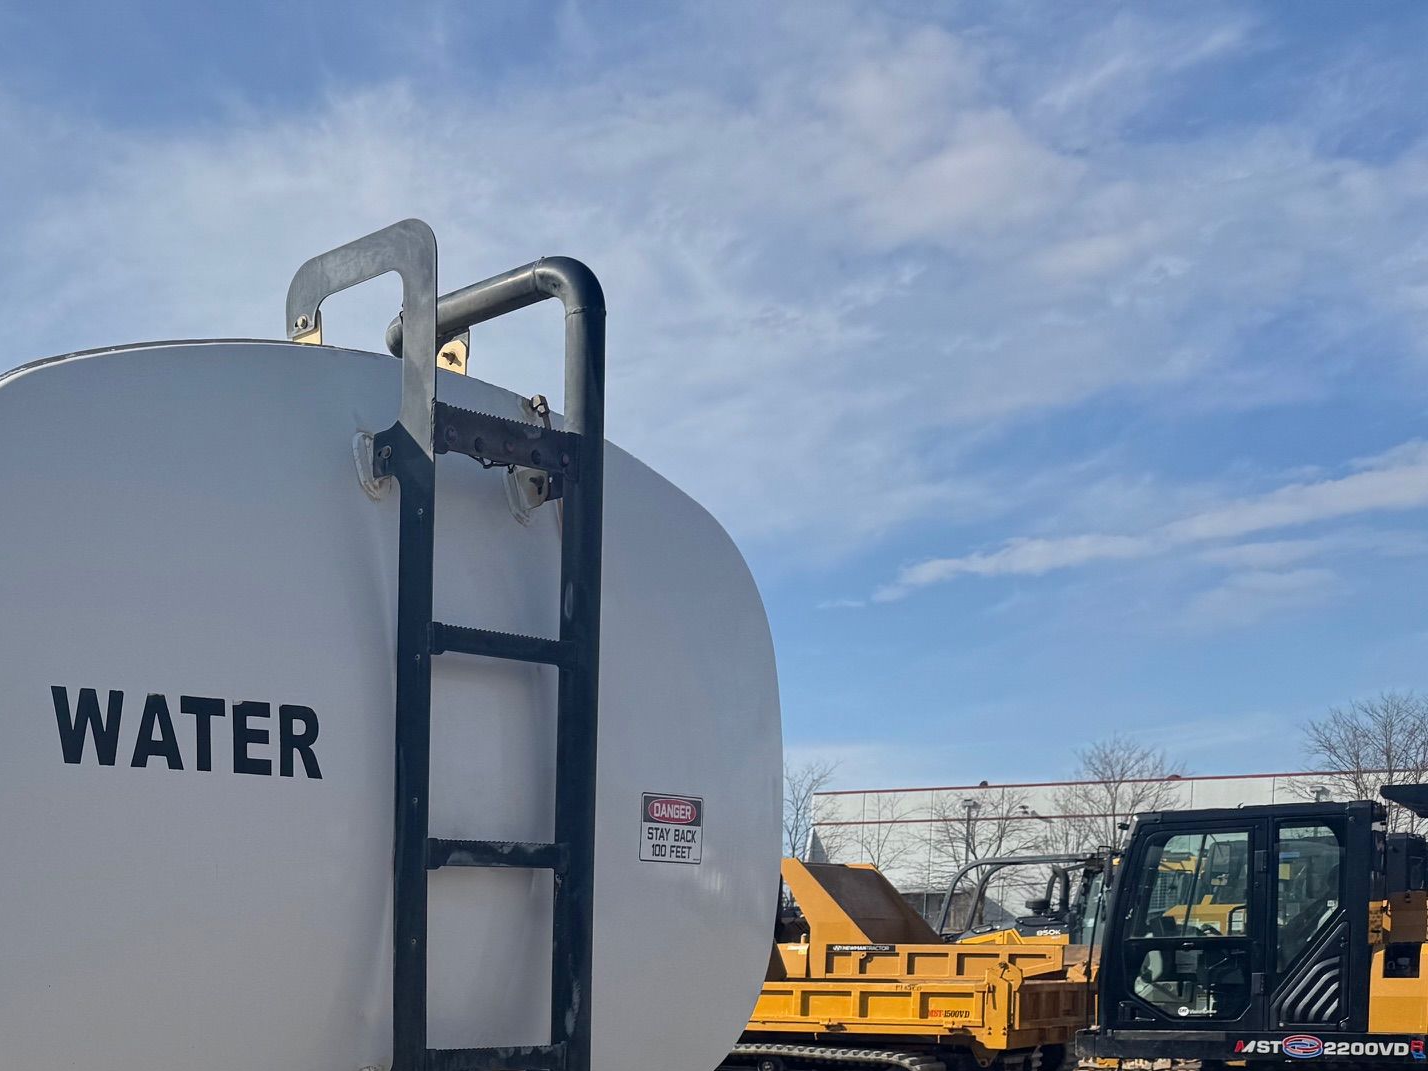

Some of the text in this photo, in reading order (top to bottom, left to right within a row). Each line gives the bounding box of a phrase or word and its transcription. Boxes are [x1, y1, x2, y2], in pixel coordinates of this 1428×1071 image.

[50, 685, 323, 779] WATER
[653, 802, 692, 820] DANGER
[647, 826, 697, 843] STAY BACK
[652, 843, 692, 859] 100 FEET
[1234, 1040, 1283, 1053] MST
